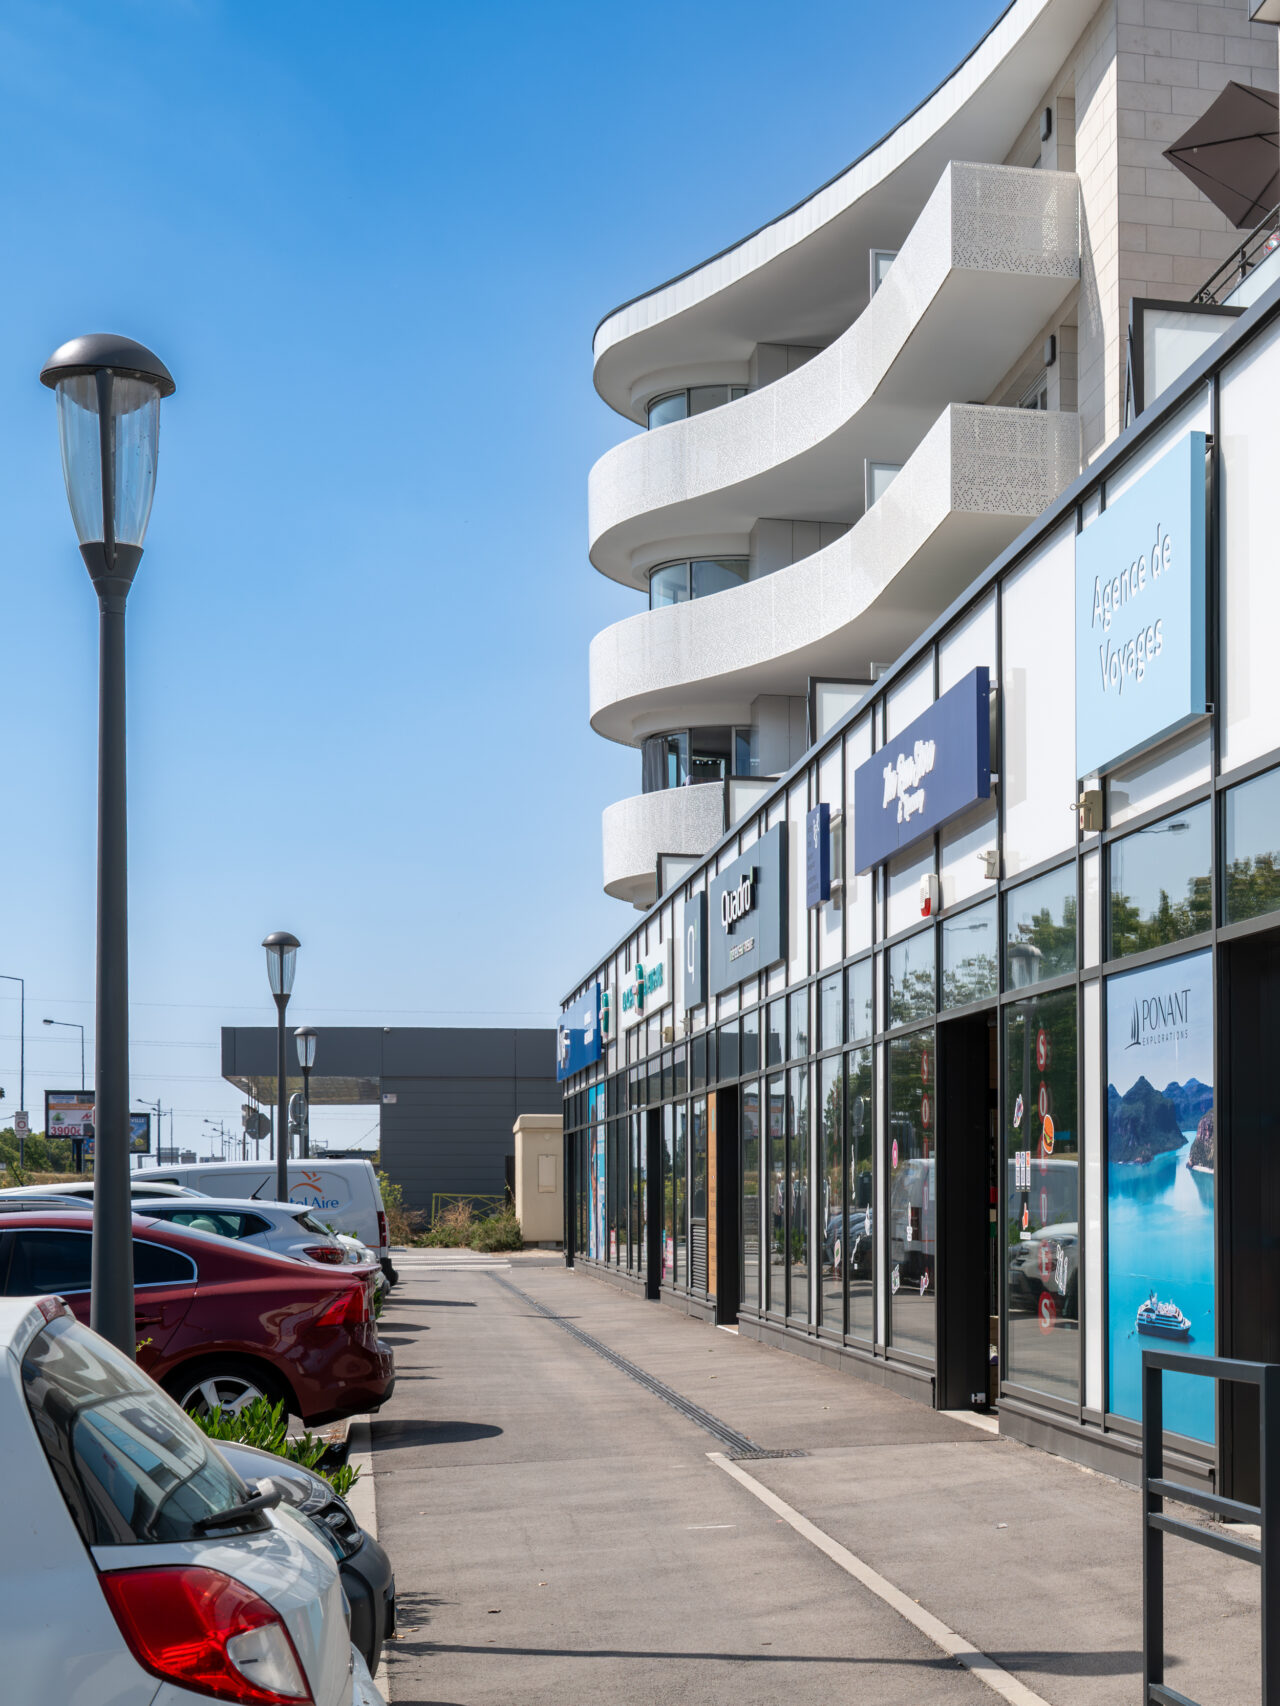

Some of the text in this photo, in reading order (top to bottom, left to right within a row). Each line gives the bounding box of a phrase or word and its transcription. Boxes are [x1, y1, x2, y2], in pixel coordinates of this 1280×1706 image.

[1092, 522, 1172, 633] Agence de
[1099, 618, 1163, 696] Voyages
[1142, 988, 1191, 1032] PONANT
[1142, 1029, 1189, 1046] EXPLORATIONS
[311, 1196, 339, 1209] Aire
